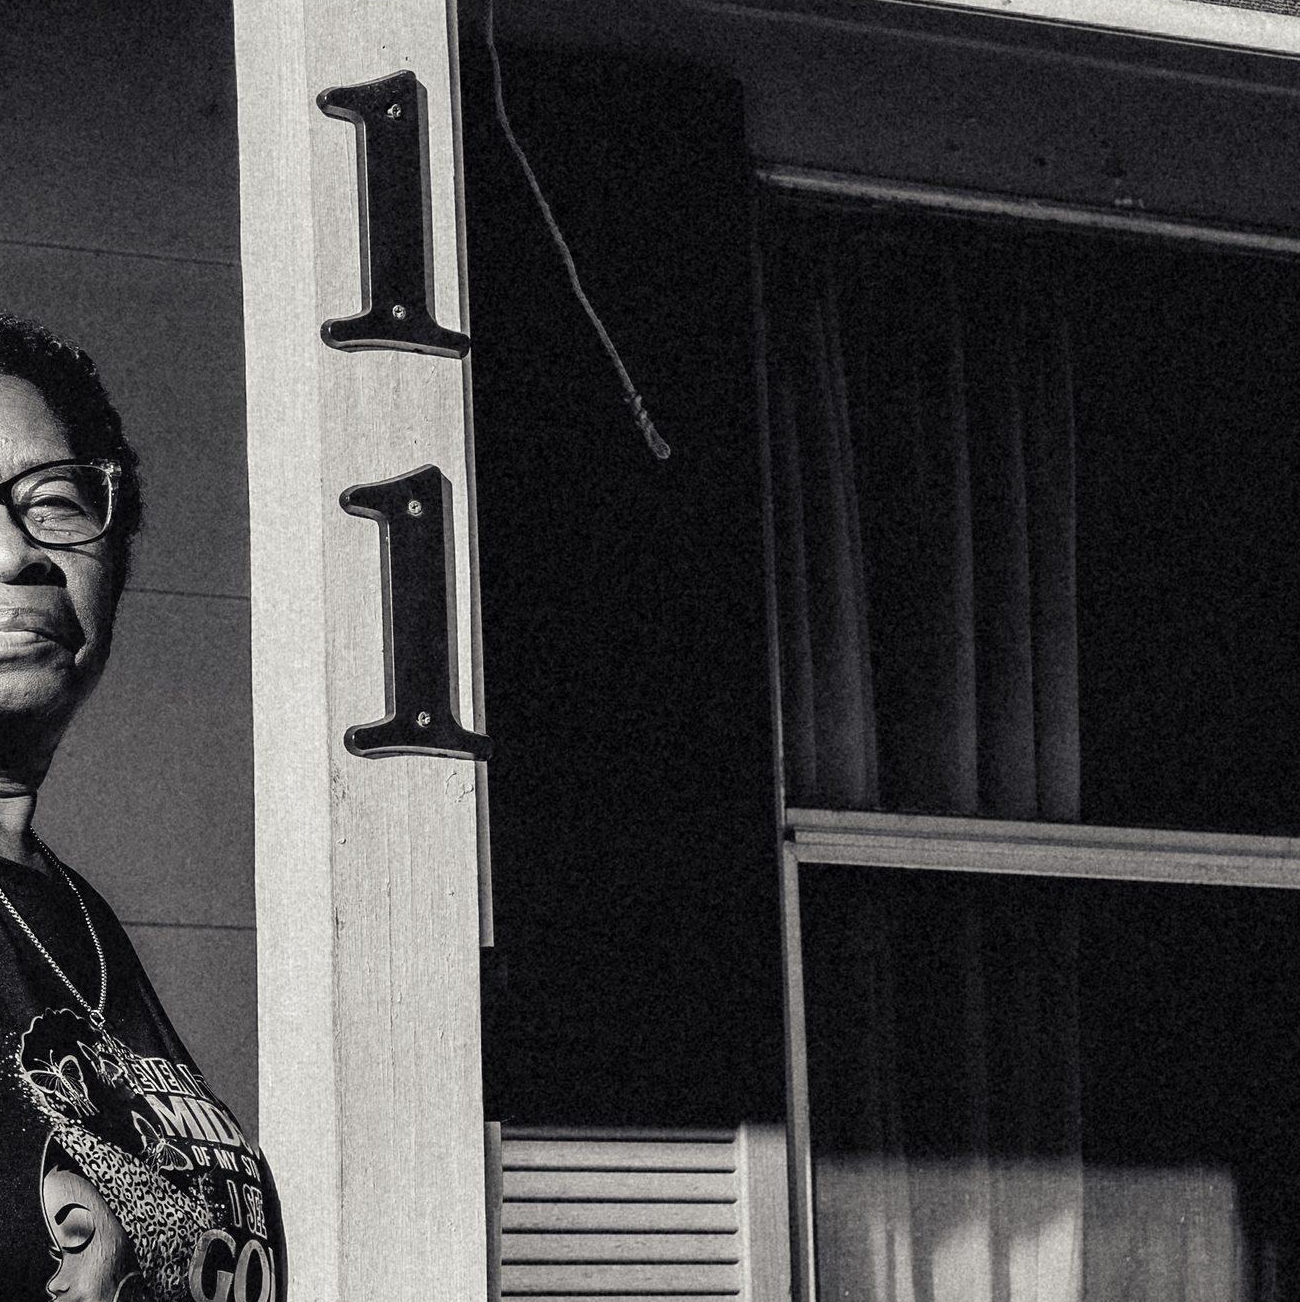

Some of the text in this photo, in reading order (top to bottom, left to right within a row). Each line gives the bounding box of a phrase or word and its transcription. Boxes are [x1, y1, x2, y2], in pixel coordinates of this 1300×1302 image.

[144, 1094, 254, 1157] MID
[191, 1145, 211, 1167] OF
[214, 1148, 240, 1172] MY
[226, 1179, 242, 1228] I
